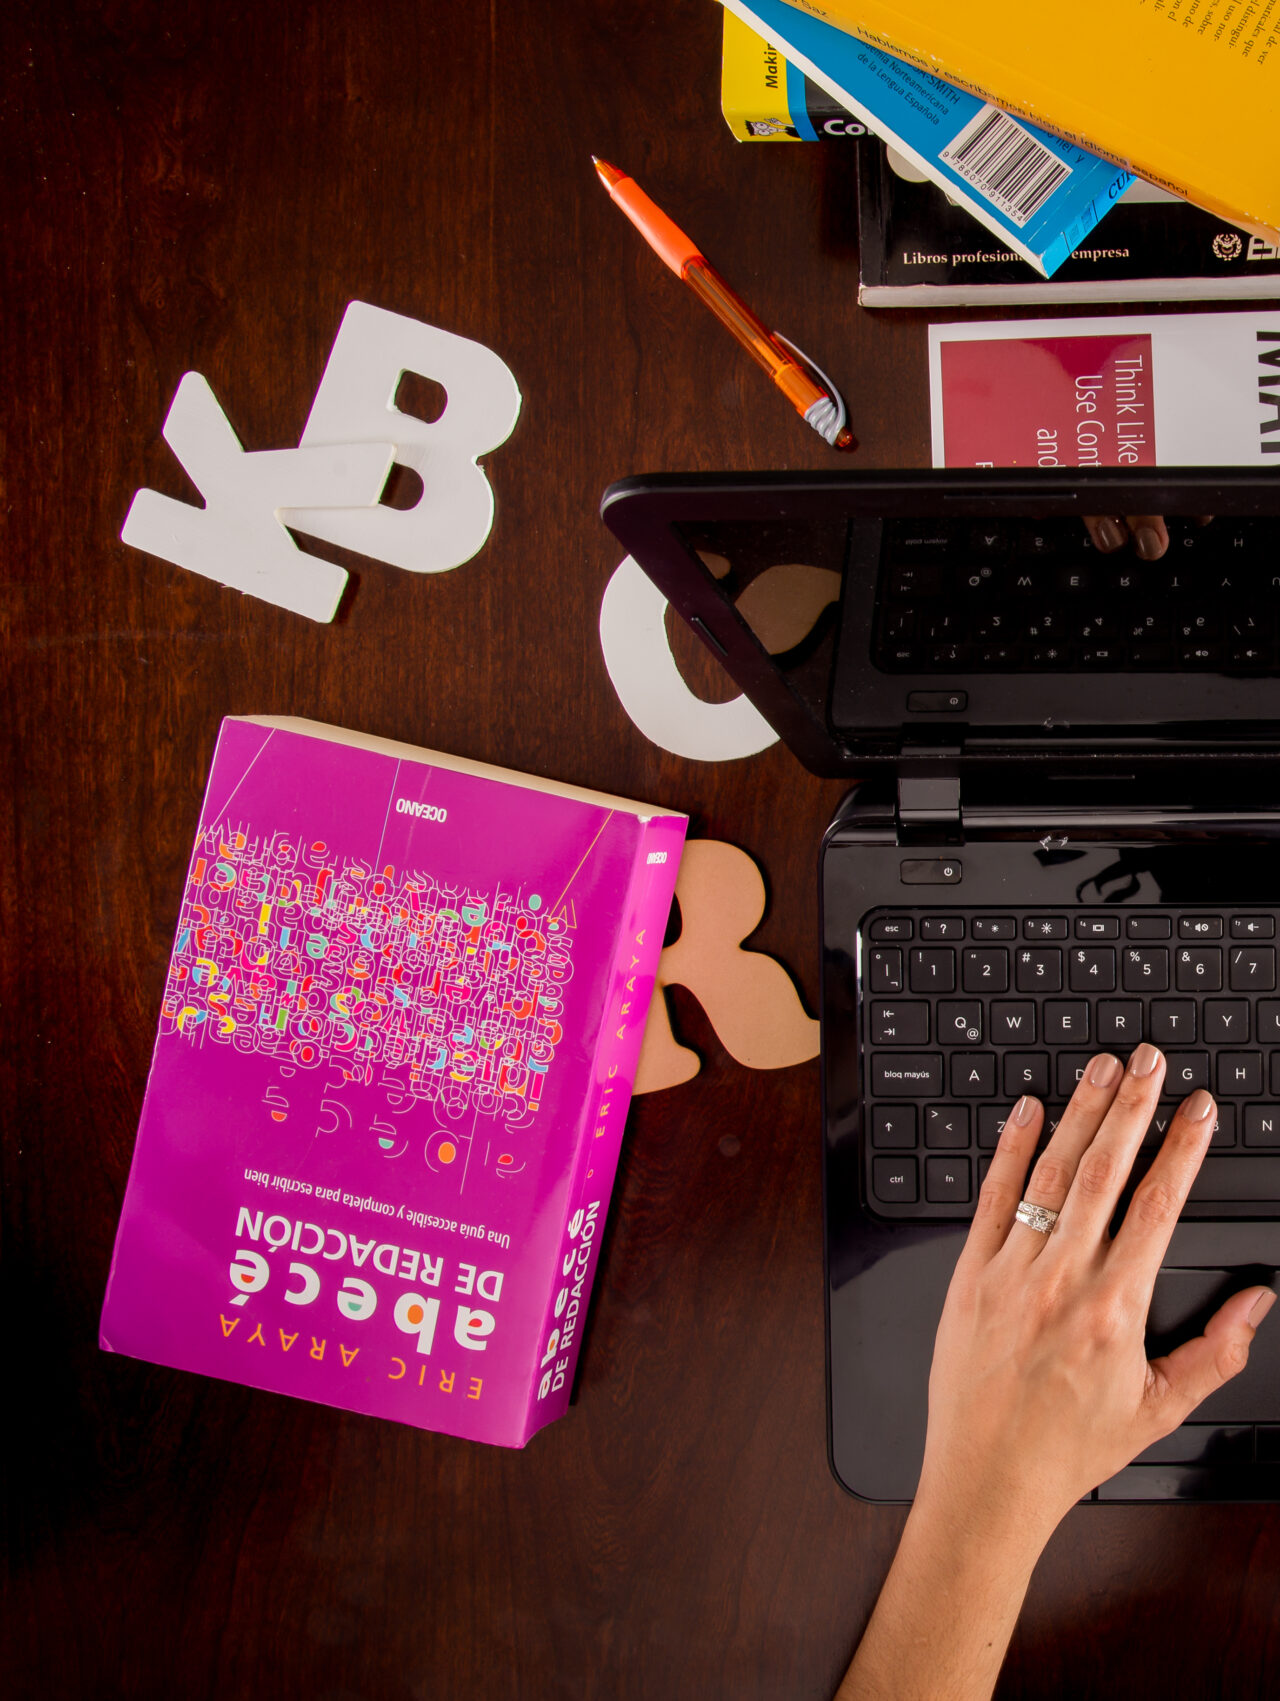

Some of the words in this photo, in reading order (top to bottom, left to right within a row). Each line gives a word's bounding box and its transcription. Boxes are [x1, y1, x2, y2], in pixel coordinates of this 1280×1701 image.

[1168, 12, 1177, 22] el
[1223, 5, 1236, 21] uso
[1182, 15, 1194, 28] de
[1197, 10, 1214, 35] sobre
[1229, 5, 1256, 49] distingui-
[1214, 23, 1226, 41] nor-
[1242, 40, 1255, 57] que
[1266, 36, 1278, 48] de
[1257, 51, 1268, 65] ver
[857, 53, 869, 64] de
[868, 60, 878, 72] la
[876, 68, 905, 95] Lengua
[904, 92, 940, 125] Española
[889, 61, 949, 116] Norteamericana
[857, 26, 929, 67] Hablemos
[932, 65, 939, 73] y
[944, 71, 1026, 116] escribamos
[1029, 111, 1061, 131] bien
[1064, 129, 1077, 141] el
[1081, 138, 1129, 166] idioma
[1132, 163, 1188, 196] español
[942, 151, 950, 159] 9
[953, 160, 988, 191] 786070
[988, 191, 1023, 222] 911354
[903, 252, 948, 265] Libros
[1071, 247, 1130, 261] empresa
[1114, 354, 1144, 415] Think
[1074, 375, 1103, 414] Use
[1037, 427, 1066, 468] and
[1076, 419, 1104, 467] Cont
[1117, 420, 1146, 464] Like
[395, 797, 448, 823] OCEANO
[646, 850, 667, 866] OCEANO
[932, 965, 935, 975] 1
[983, 965, 990, 975] 2
[1037, 965, 1044, 975] 3
[1090, 965, 1098, 974] 4
[1144, 964, 1150, 974] 5
[1196, 964, 1204, 974] 6
[1250, 963, 1256, 973] 7
[954, 1016, 967, 1029] Q
[1007, 1017, 1021, 1028] W
[1063, 1017, 1071, 1027] E
[1116, 1016, 1125, 1027] R
[1170, 1016, 1178, 1027] T
[1223, 1016, 1232, 1026] Y
[595, 1062, 619, 1139] ERIC
[616, 927, 647, 1039] ARAYA
[905, 1071, 929, 1079] mayús
[969, 1070, 979, 1080] A
[1024, 1069, 1031, 1080] S
[1183, 1069, 1192, 1079] G
[1236, 1068, 1245, 1079] H
[1157, 1121, 1166, 1131] V
[1263, 1120, 1272, 1131] N
[244, 1168, 270, 1188] bien
[270, 1176, 313, 1195] escribir
[315, 1186, 341, 1202] para
[342, 1193, 395, 1216] completa
[396, 1204, 406, 1219] y
[406, 1210, 458, 1232] accesible
[460, 1223, 485, 1239] guía
[235, 1207, 444, 1287] REDACCIÓN
[487, 1230, 511, 1249] Una
[454, 1262, 504, 1302] DE
[229, 1249, 497, 1356] abecé
[537, 1208, 585, 1401] abecé
[551, 1356, 569, 1393] DE
[560, 1200, 601, 1350] REDACCIÓN
[219, 1313, 361, 1368] ARAYA
[388, 1357, 484, 1401] ERIC
